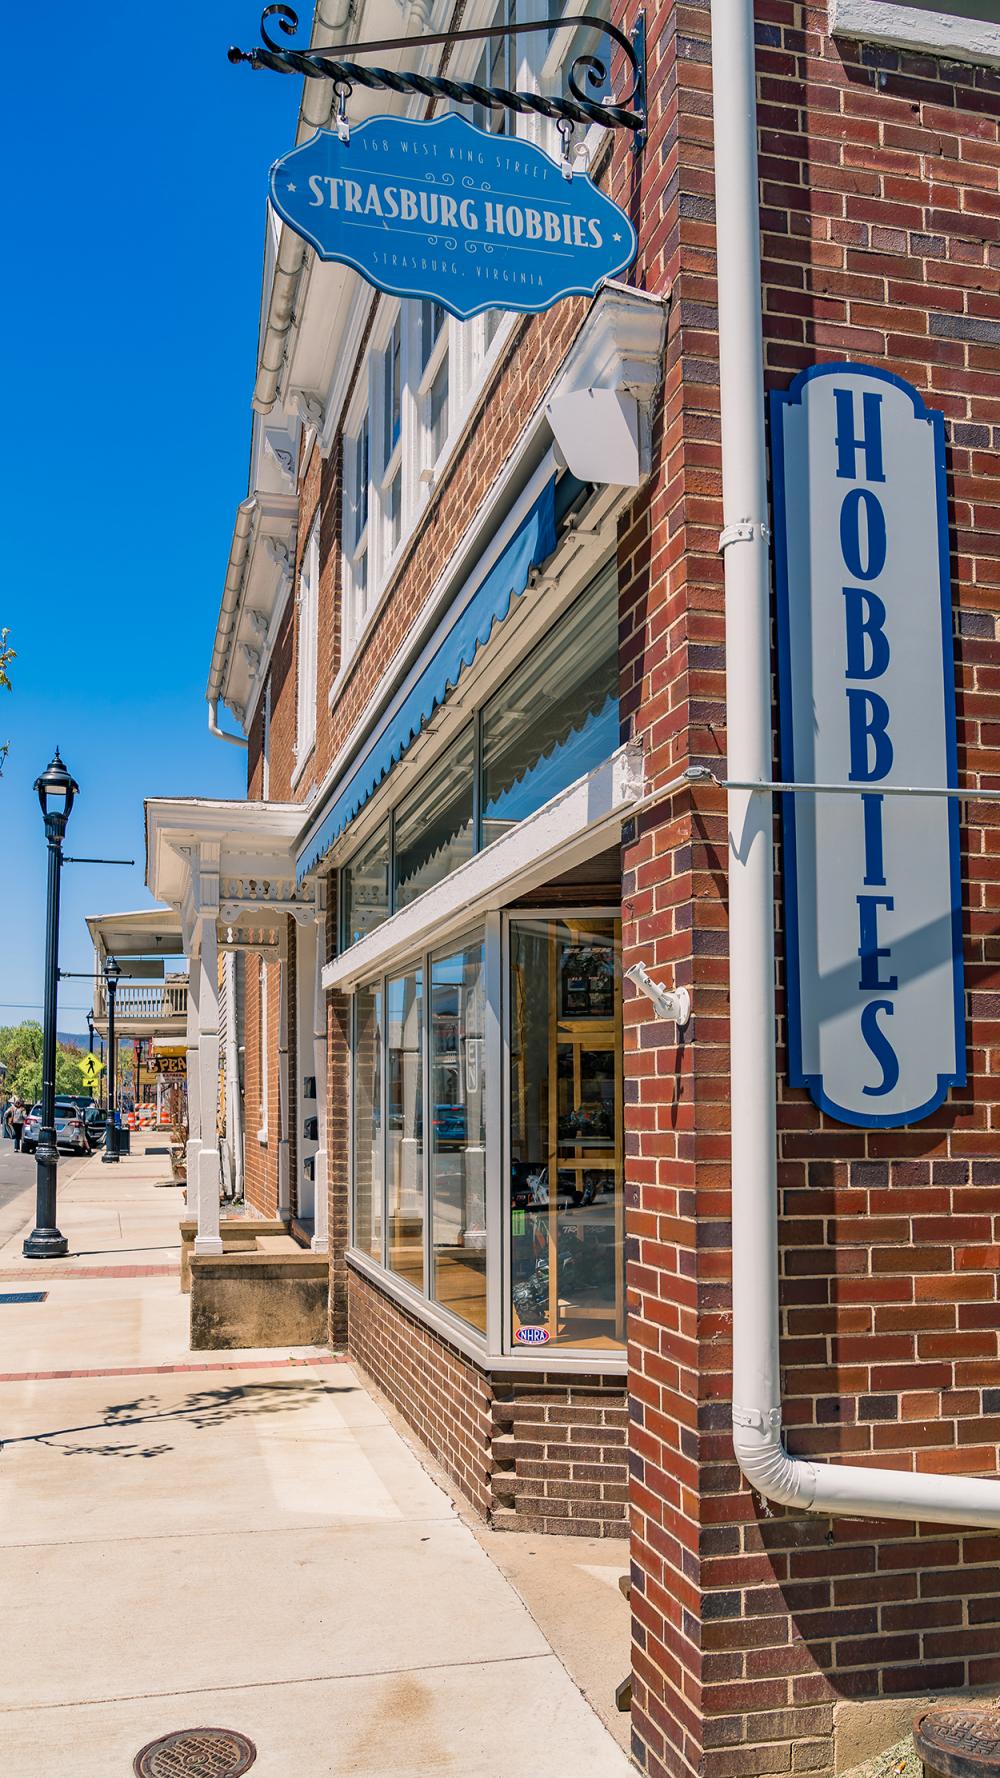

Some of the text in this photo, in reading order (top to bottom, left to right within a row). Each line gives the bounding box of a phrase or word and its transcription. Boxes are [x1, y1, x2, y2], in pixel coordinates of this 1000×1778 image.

[363, 139, 548, 181] 168 WEST KING STREET
[308, 175, 603, 249] STRASBURG HOBBIES
[476, 266, 543, 287] VIRGINIA
[833, 388, 899, 1097] HOBBIES
[521, 1329, 545, 1341] NHRA
